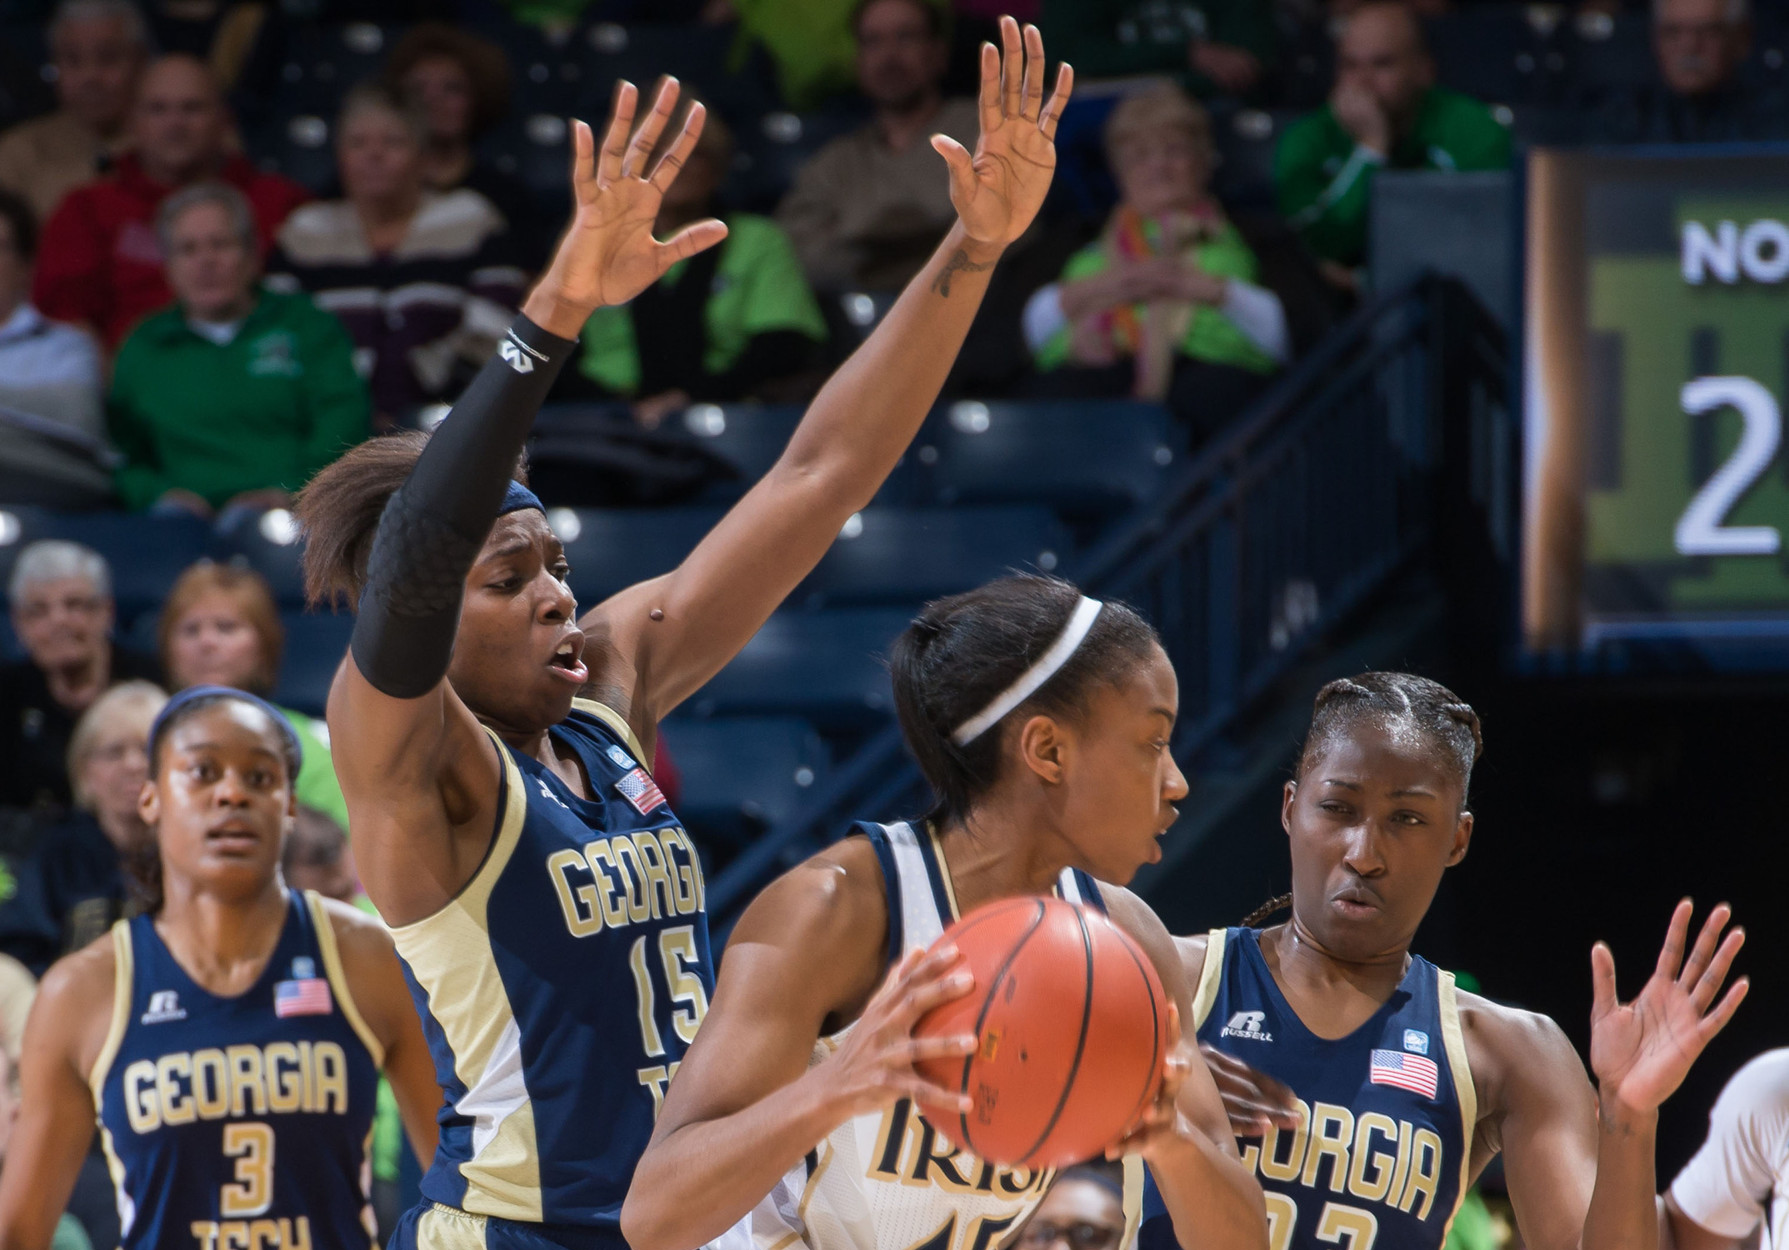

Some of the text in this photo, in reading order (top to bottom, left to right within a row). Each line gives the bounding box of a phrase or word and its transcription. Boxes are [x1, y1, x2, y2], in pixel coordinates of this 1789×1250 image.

[1682, 220, 1789, 284] NO
[1674, 376, 1782, 555] 2
[629, 924, 710, 1058] 15
[1221, 1026, 1274, 1042] RUSSELL
[123, 1041, 348, 1135] GEORGIA
[220, 1121, 276, 1219] 3
